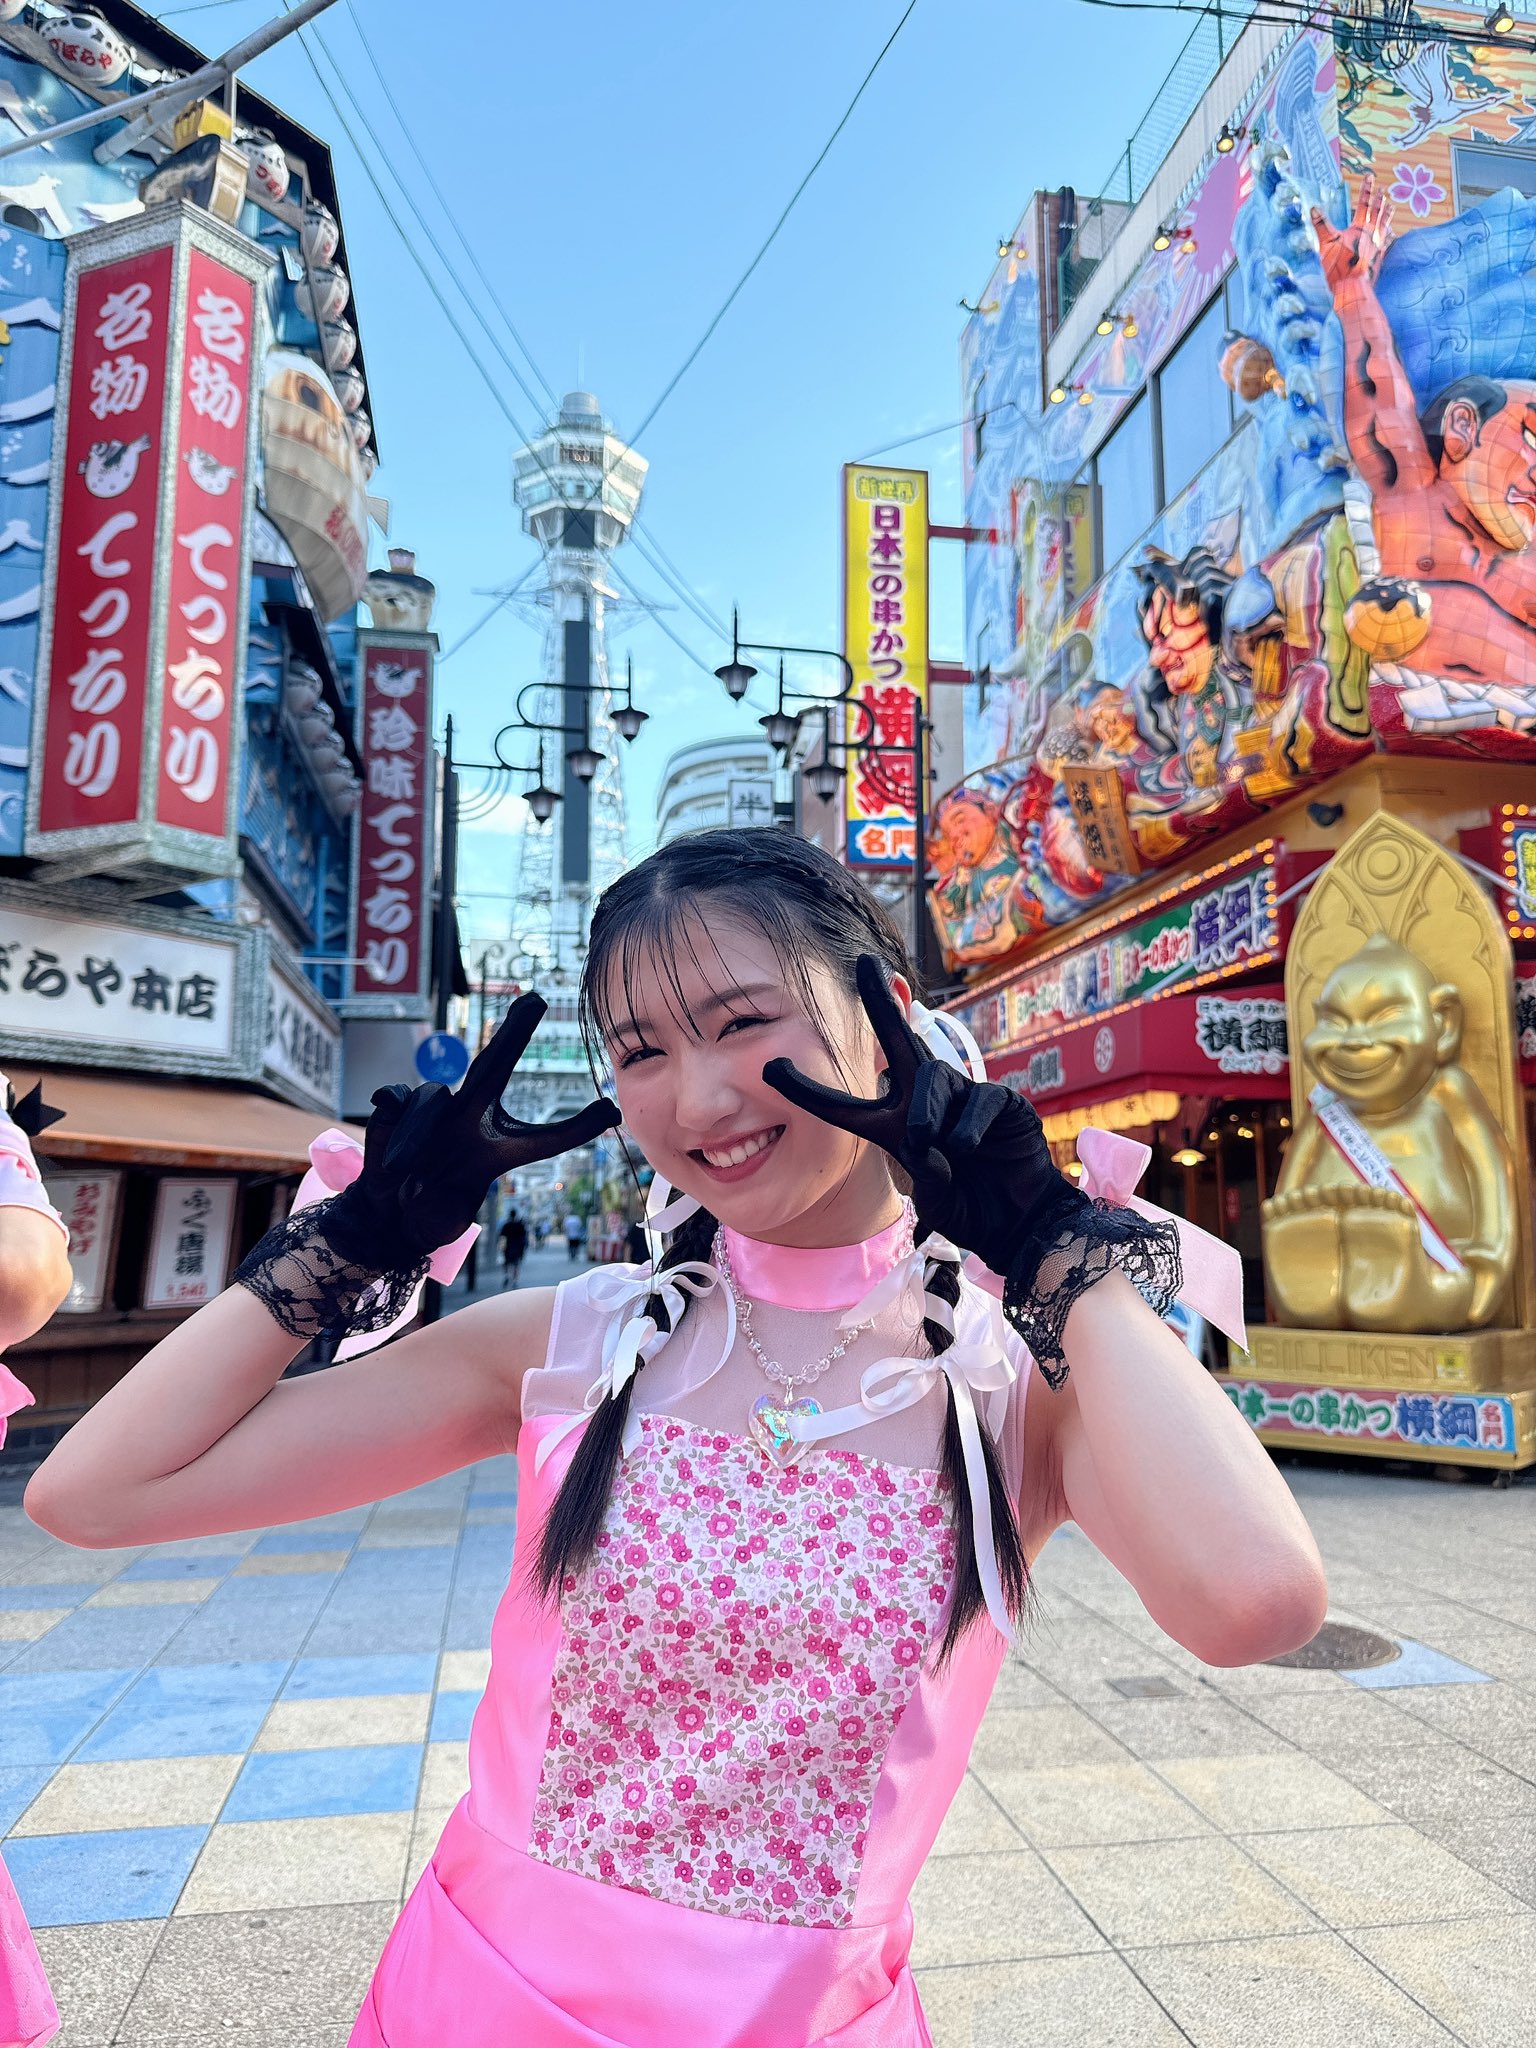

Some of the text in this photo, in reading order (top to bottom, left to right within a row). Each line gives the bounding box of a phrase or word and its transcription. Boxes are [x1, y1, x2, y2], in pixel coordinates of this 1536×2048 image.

[90, 282, 152, 421] 名物
[188, 287, 246, 429] 名物
[858, 476, 915, 500] 新世界
[872, 505, 903, 679] 日本一の串かつ
[1201, 1017, 1289, 1056] 横綱
[1254, 1338, 1437, 1379] BILLIKEN
[1396, 1398, 1479, 1443] 横綱
